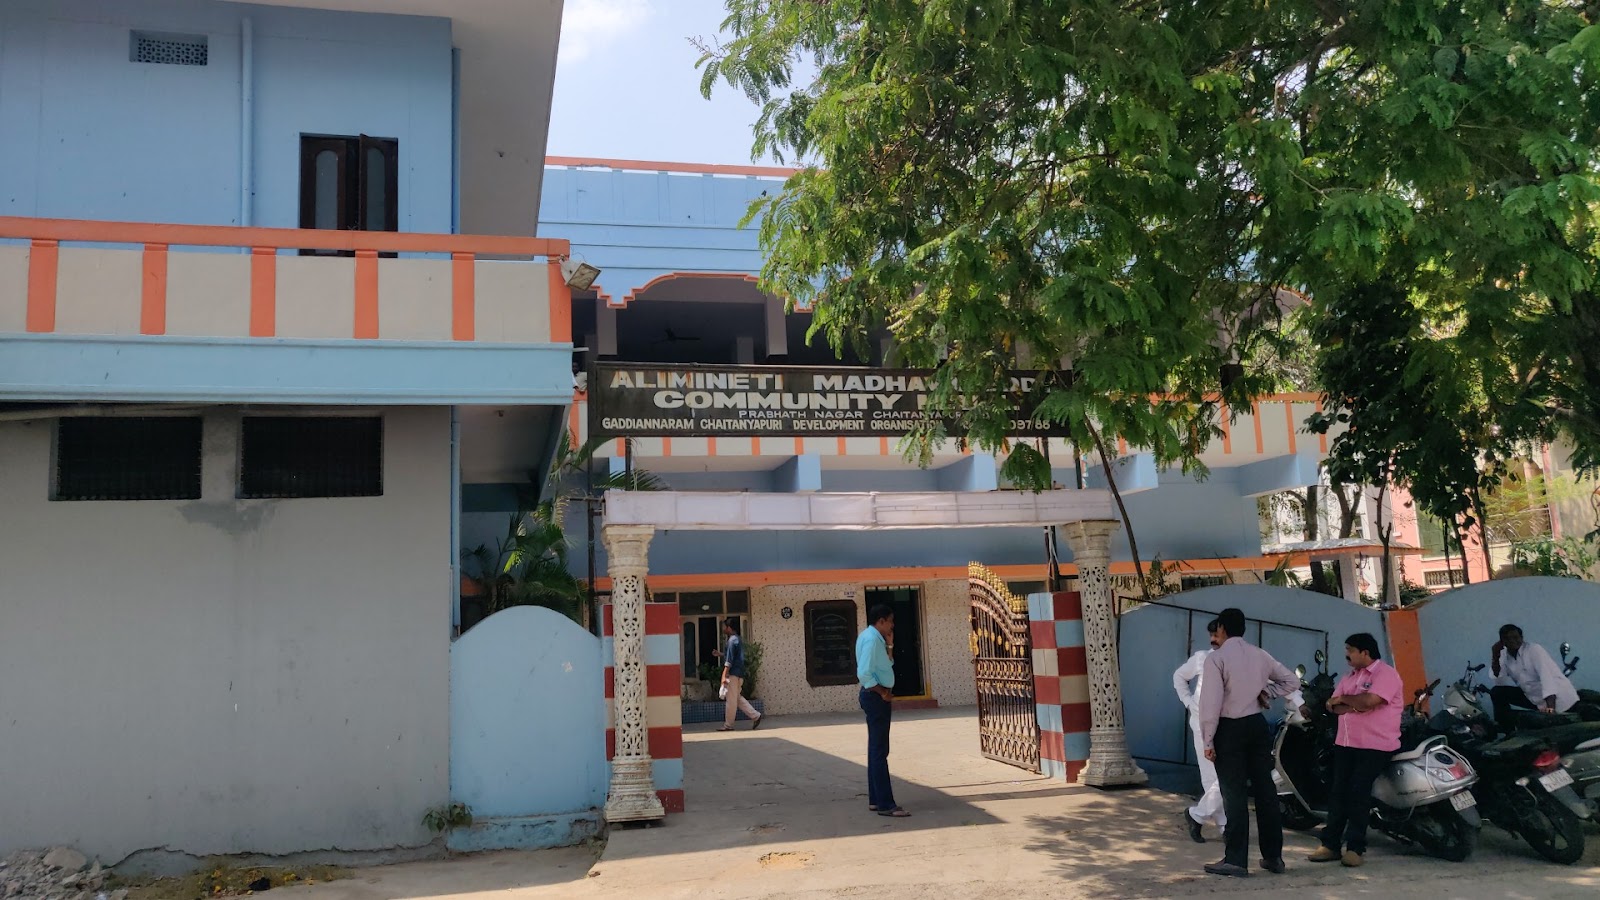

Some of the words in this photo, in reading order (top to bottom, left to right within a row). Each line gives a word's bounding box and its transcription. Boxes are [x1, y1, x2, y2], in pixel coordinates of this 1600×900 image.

[610, 370, 784, 390] ALIMINETI
[653, 390, 903, 410] COMMUNITY
[738, 410, 806, 419] PRABHATH
[814, 411, 863, 419] NAGAR
[602, 417, 695, 430] GADDIANNARAM
[700, 418, 783, 430] CHAITANYAPURI
[792, 419, 866, 430] DEVELOPMENT
